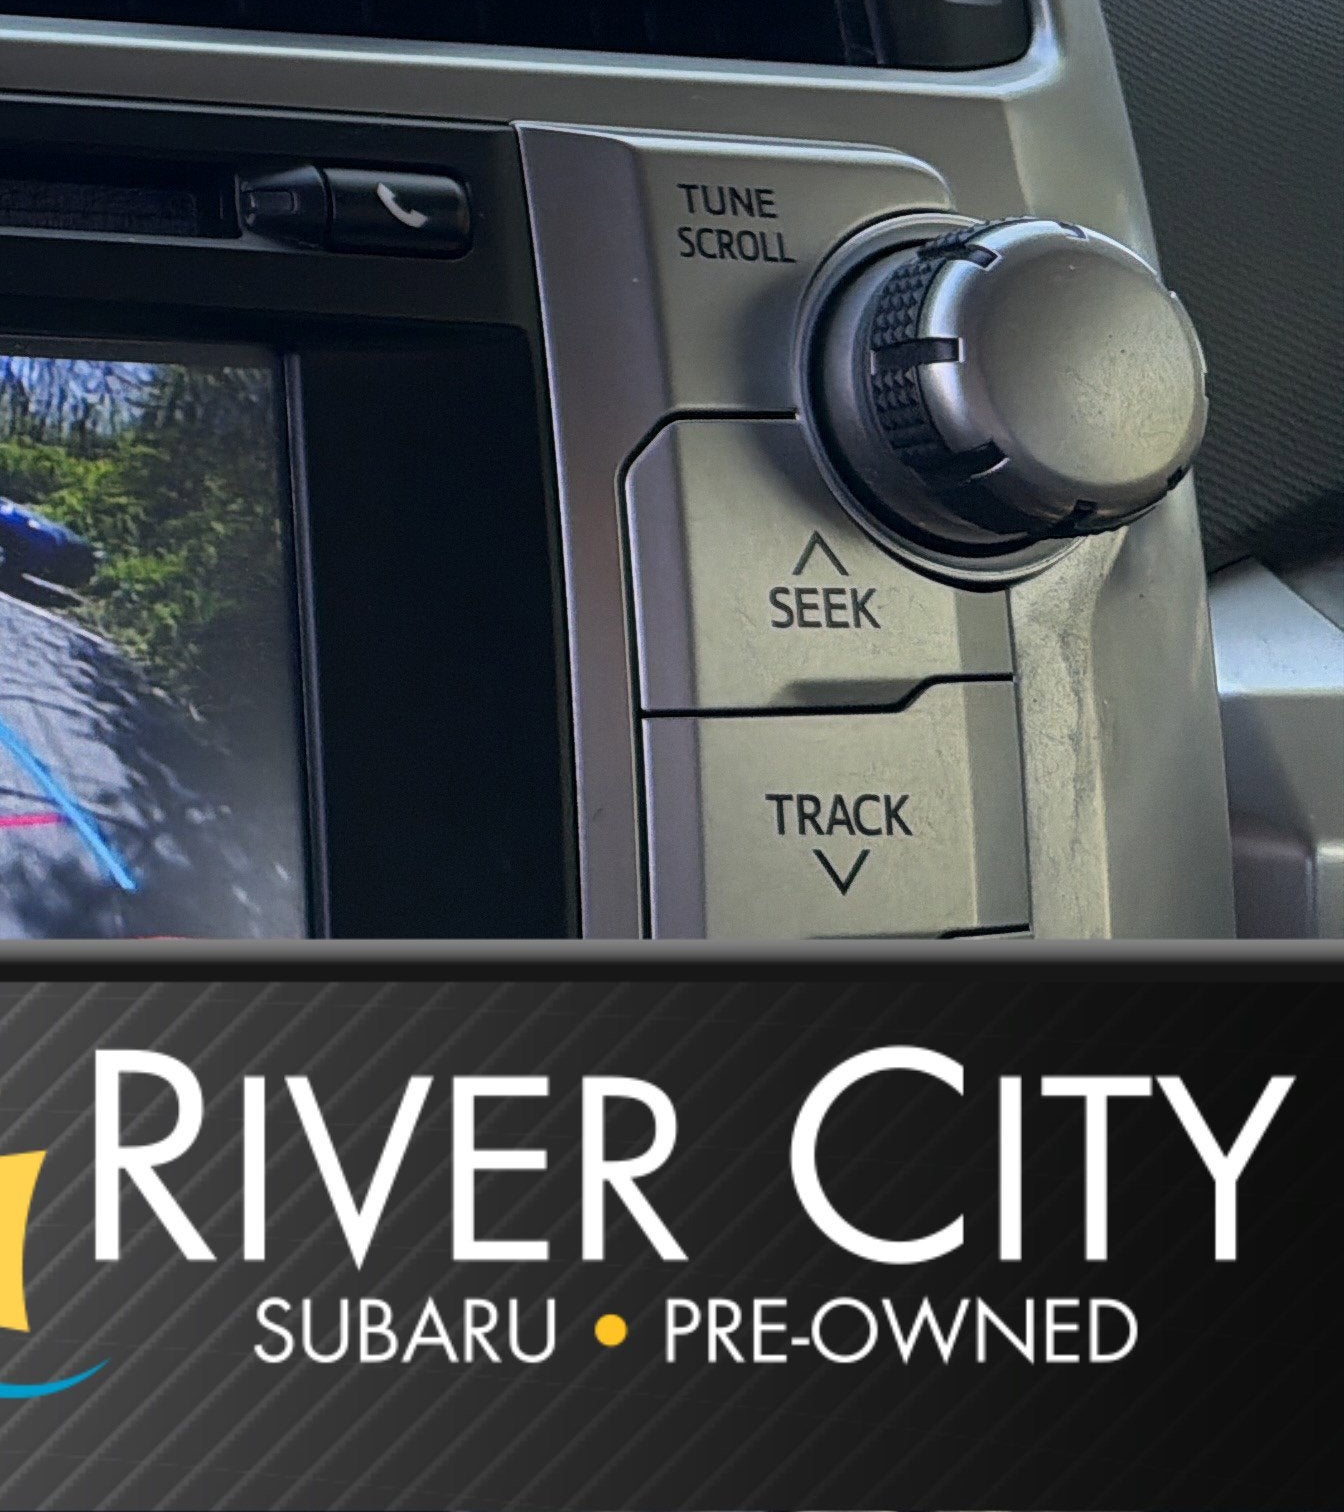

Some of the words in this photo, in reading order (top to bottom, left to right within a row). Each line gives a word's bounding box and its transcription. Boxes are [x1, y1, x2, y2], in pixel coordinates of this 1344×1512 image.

[676, 182, 779, 219] TUNE
[677, 226, 798, 264] SCROLL
[768, 585, 882, 630] SEEK
[764, 792, 914, 837] TRACK
